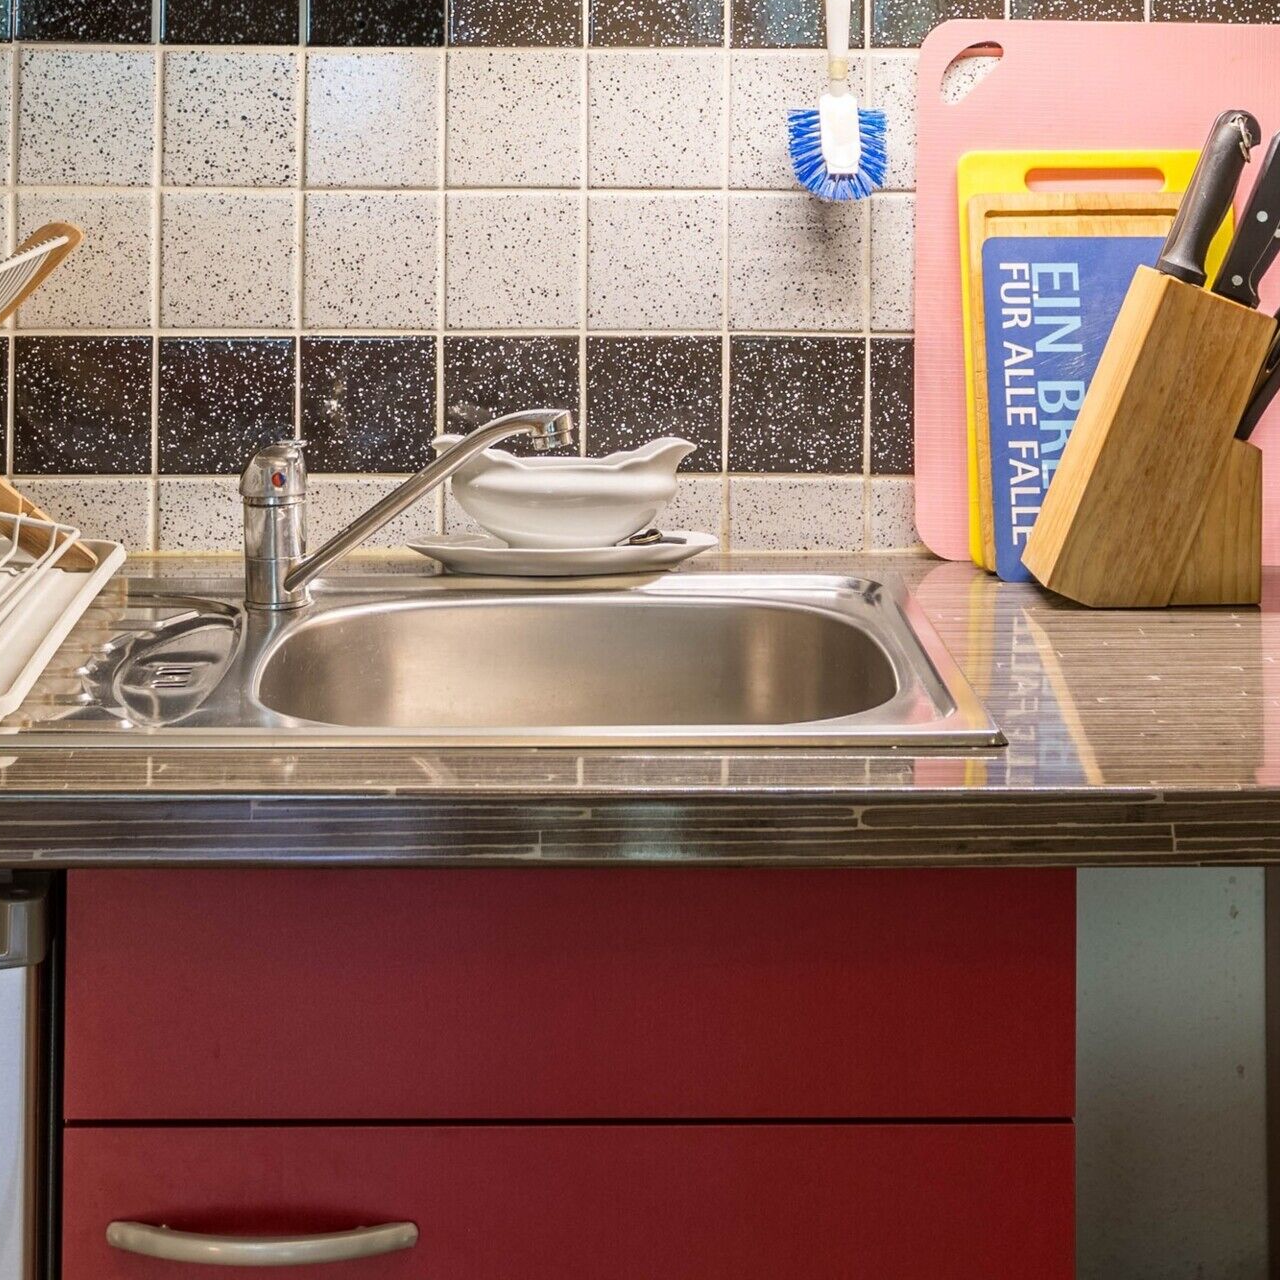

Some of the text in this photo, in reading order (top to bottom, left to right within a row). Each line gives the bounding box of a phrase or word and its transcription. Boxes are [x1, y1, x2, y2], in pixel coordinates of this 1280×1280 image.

[999, 262, 1039, 329] FÜR
[1031, 262, 1082, 352] EIN
[1003, 341, 1037, 426] ALLE
